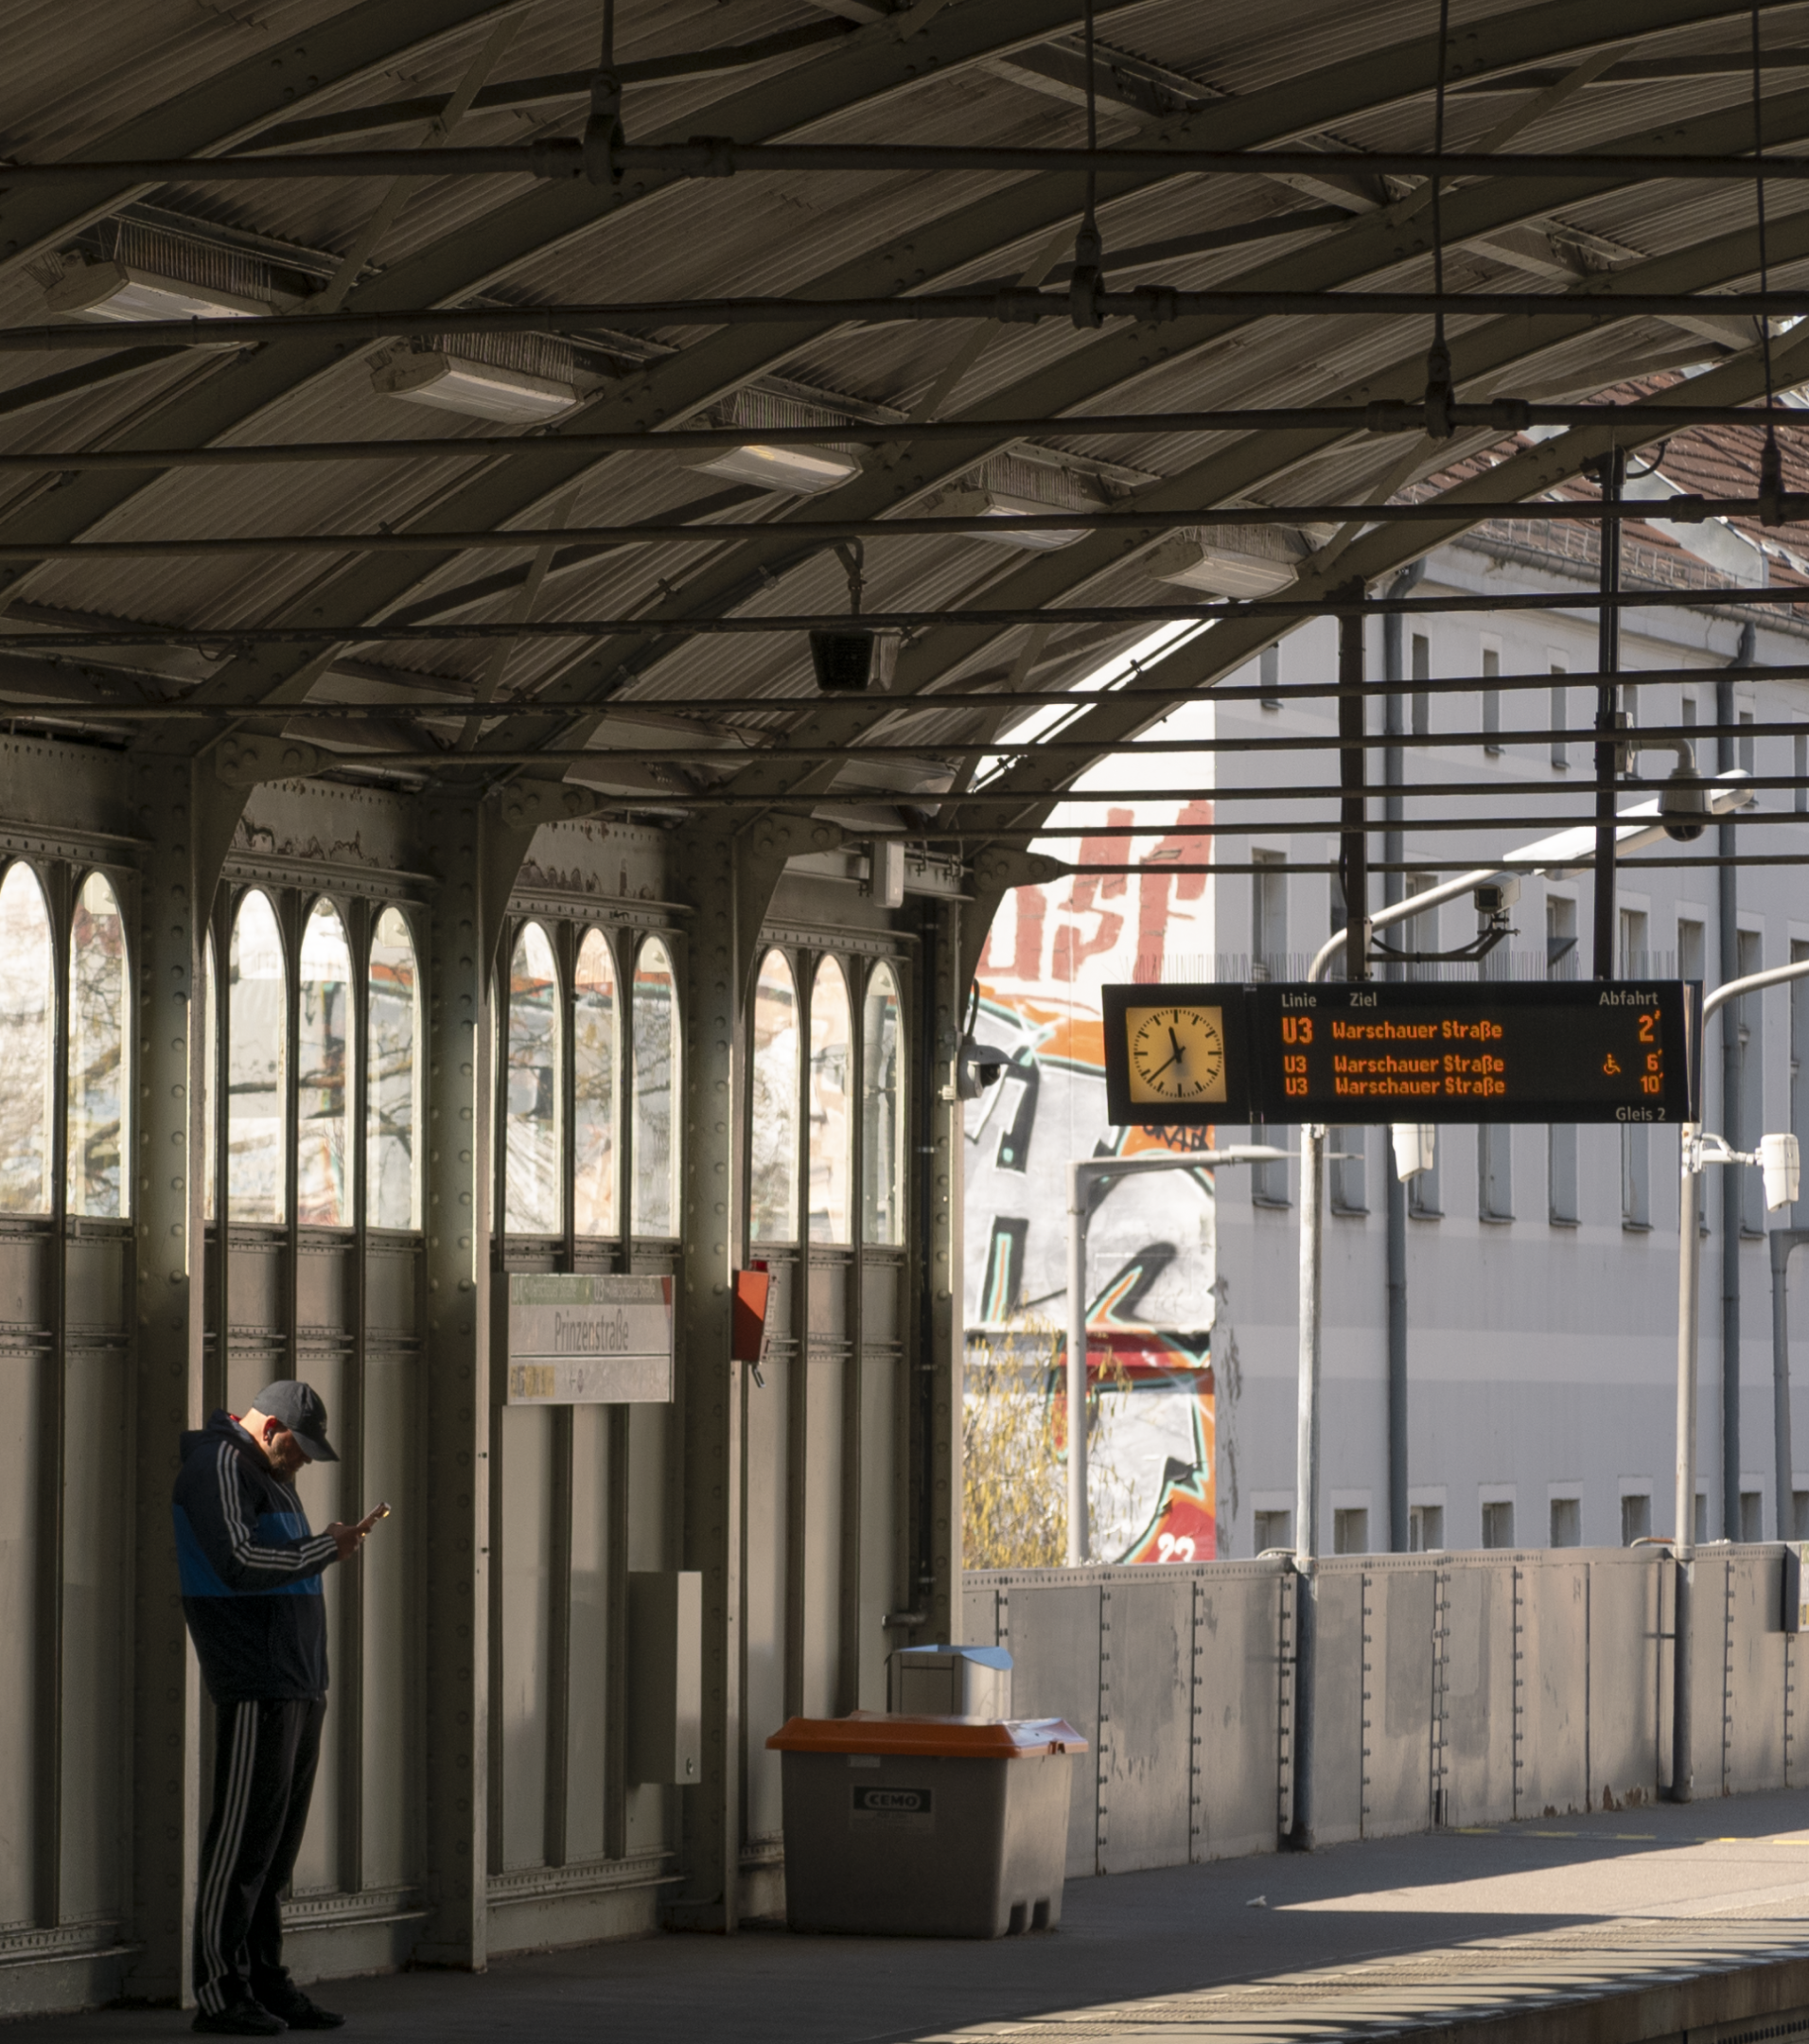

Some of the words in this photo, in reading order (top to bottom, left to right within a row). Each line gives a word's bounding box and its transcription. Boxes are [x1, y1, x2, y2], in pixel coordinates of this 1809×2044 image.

[1281, 993, 1317, 1008] Linie
[1349, 992, 1378, 1007] Ziel
[1599, 991, 1659, 1007] Abfahrt
[1282, 1016, 1313, 1044] U3
[1332, 1020, 1437, 1039] Warschauer
[1441, 1020, 1503, 1042] Straße
[1283, 1055, 1308, 1074] U3
[1334, 1055, 1439, 1074] Warschauer
[1443, 1053, 1505, 1076] Straße
[1285, 1077, 1308, 1096] U3
[1335, 1077, 1440, 1096] Warschauer
[1445, 1075, 1506, 1098] Straße
[1616, 1106, 1653, 1121] Gleis
[1657, 1107, 1666, 1121] 2
[593, 1278, 605, 1302] U3
[554, 1309, 628, 1352] Prinzenstraße
[869, 1793, 917, 1806] CEMO
